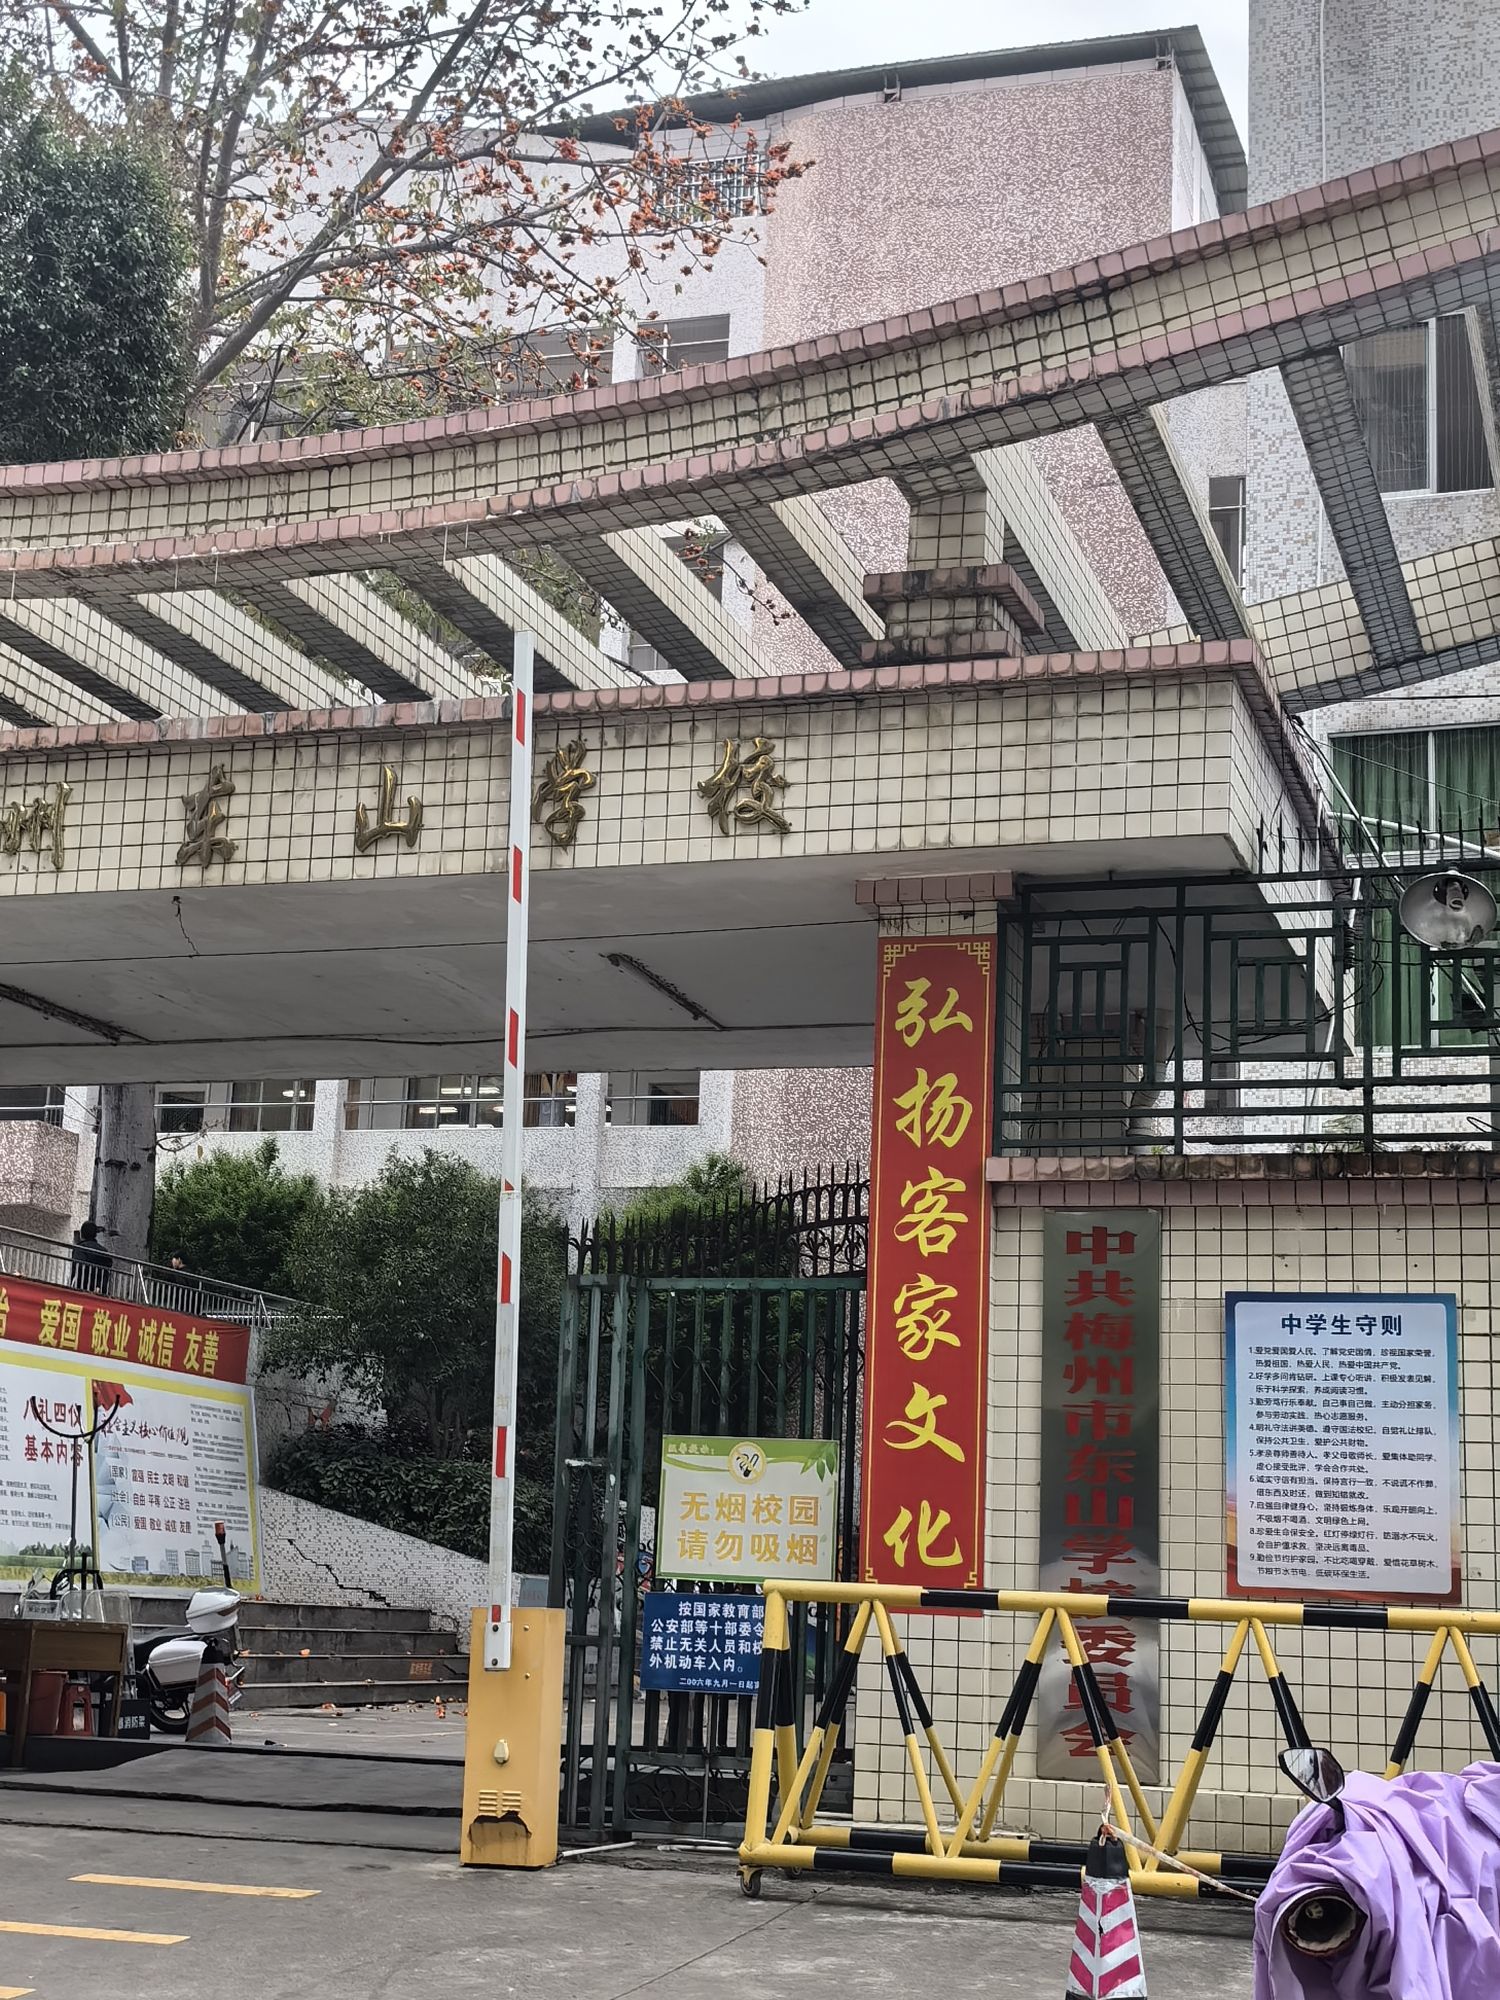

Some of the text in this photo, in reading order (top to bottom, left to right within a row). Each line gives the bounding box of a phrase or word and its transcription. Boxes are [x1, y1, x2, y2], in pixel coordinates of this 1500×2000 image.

[882, 976, 974, 1568] 弘扬客家文化
[38, 1298, 84, 1351] 爱国
[91, 1308, 131, 1359] 敬业
[138, 1317, 176, 1368] 诚信
[183, 1327, 220, 1375] 友善
[1281, 1313, 1402, 1336] 中学生守则
[23, 1396, 82, 1428] 八礼四仪
[24, 1434, 84, 1467] 基本内容
[680, 1491, 819, 1527] 无烟校园
[677, 1529, 819, 1566] 请勿吸烟
[679, 1601, 764, 1619] 按国家教育部
[651, 1618, 764, 1637] 公安部等十部委令
[649, 1636, 763, 1655] 禁止无关人员和校
[649, 1654, 743, 1673] 外机动车入内。
